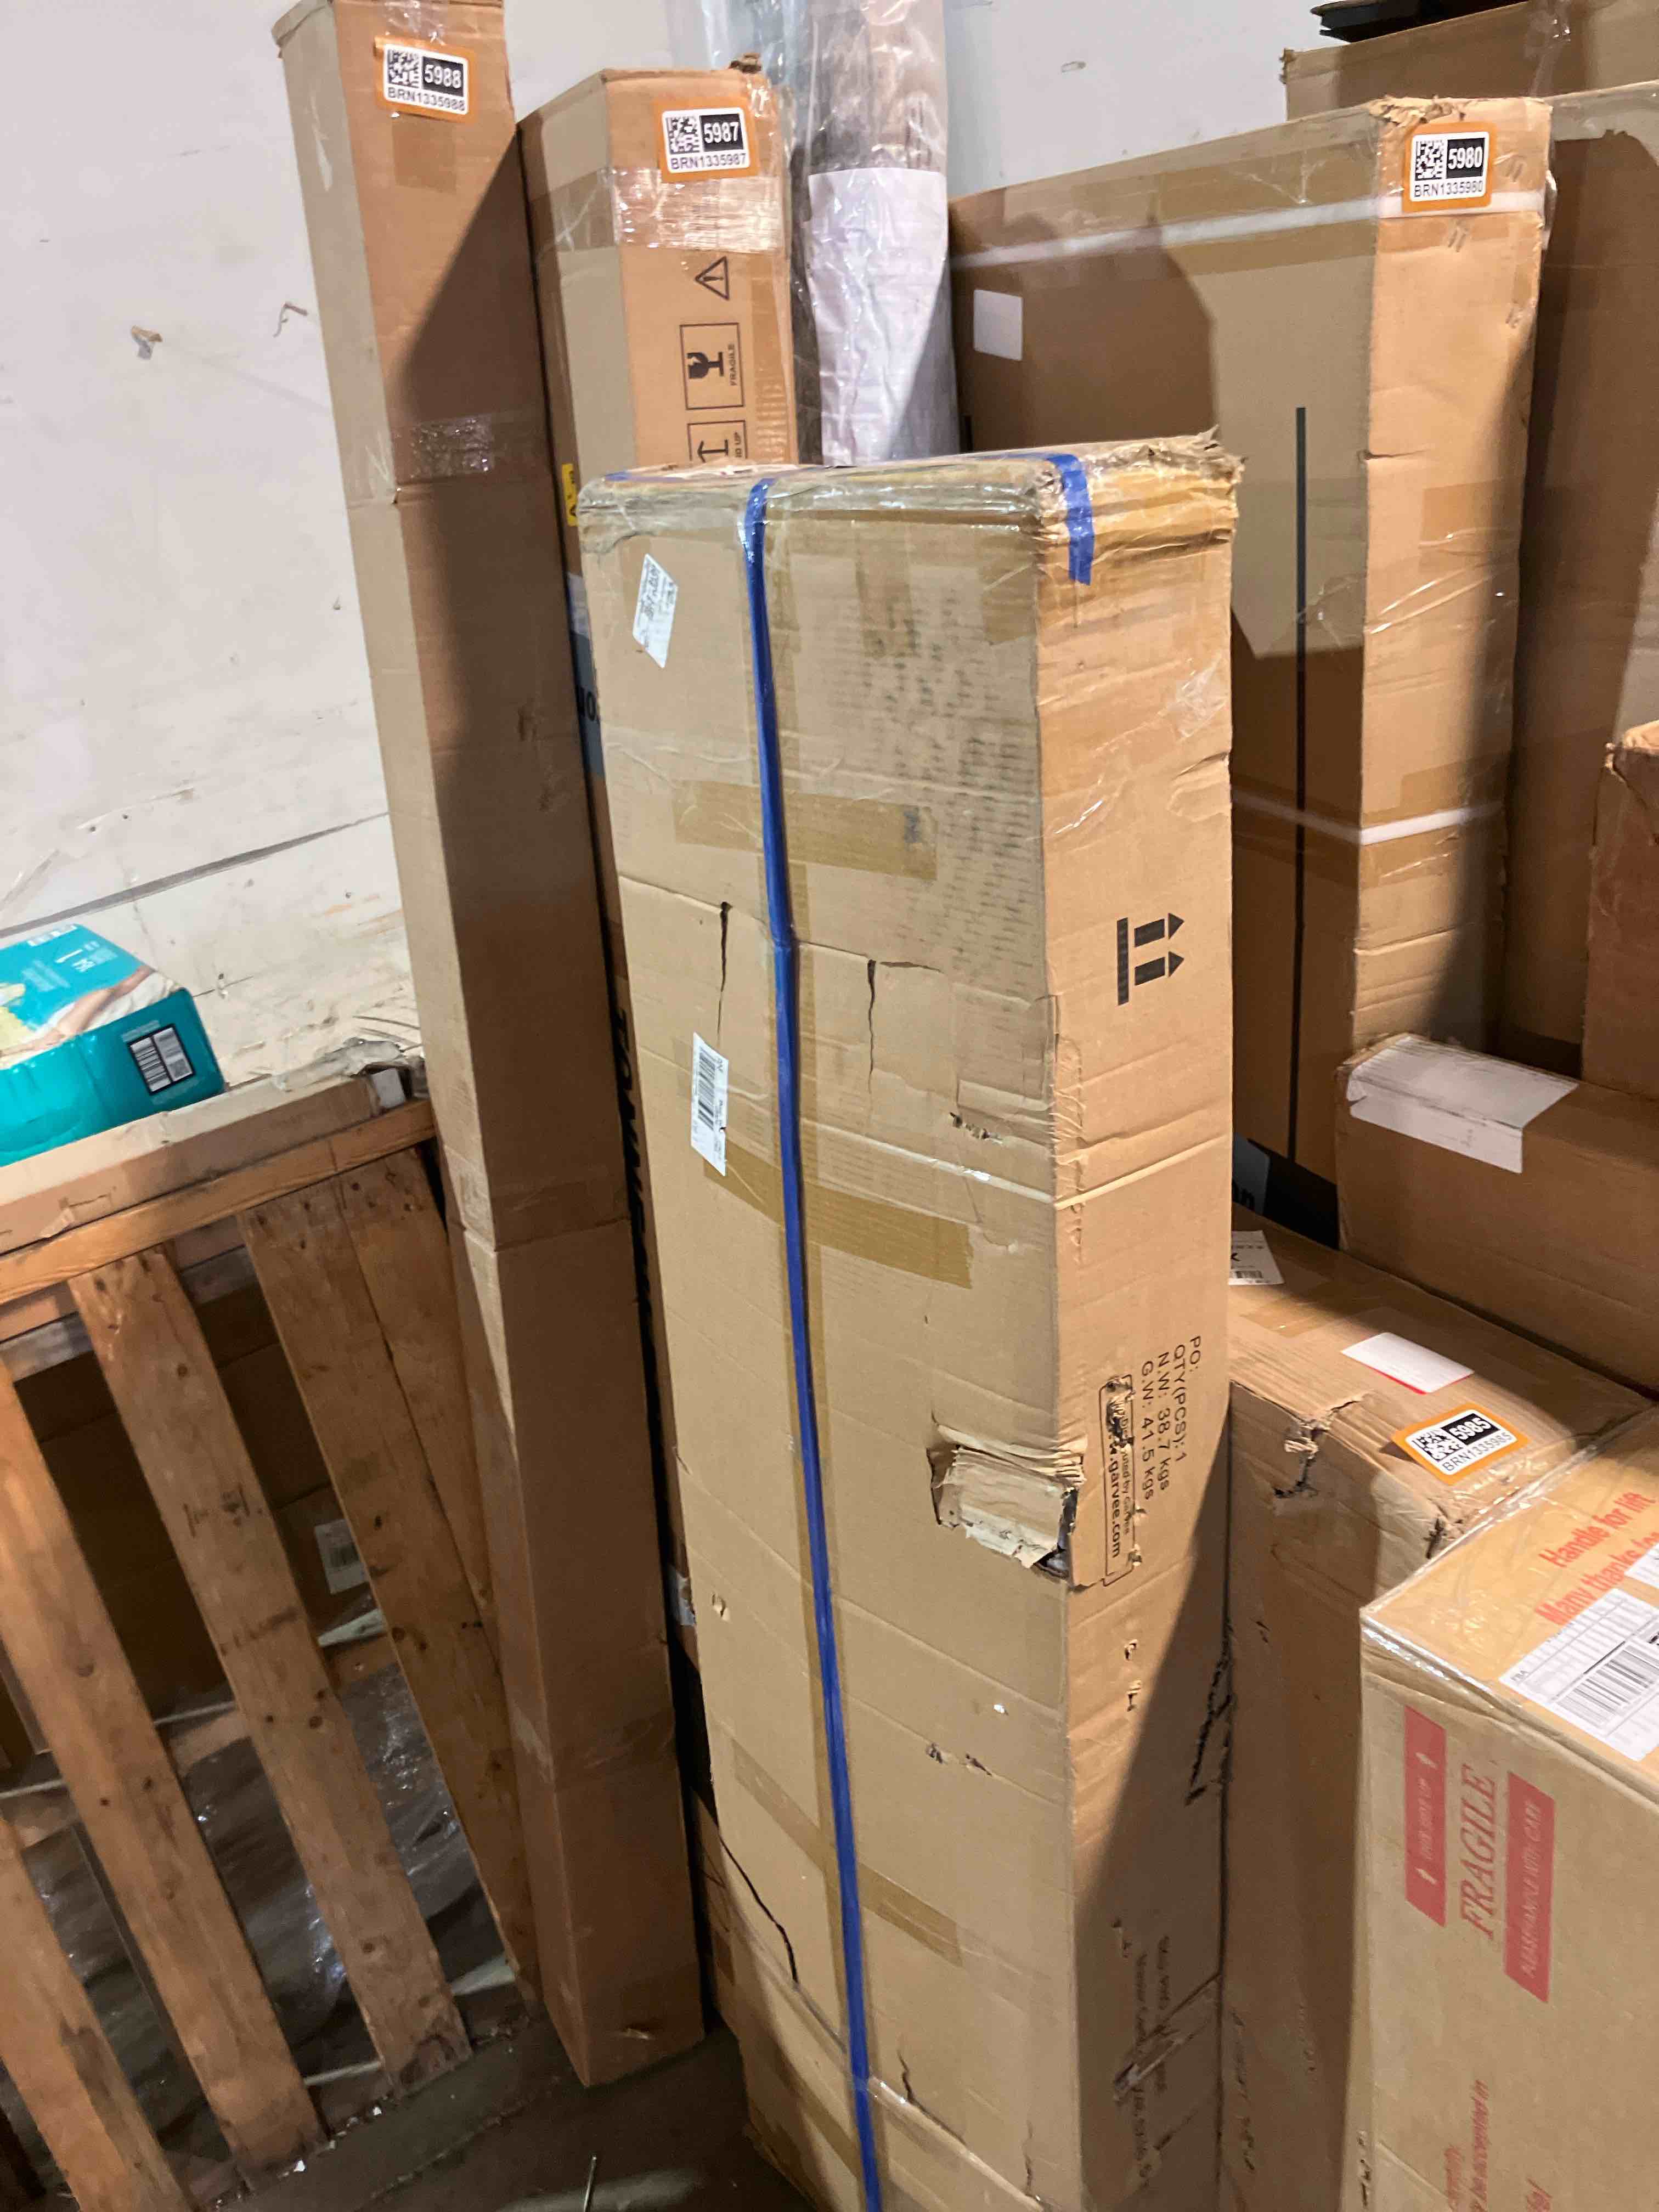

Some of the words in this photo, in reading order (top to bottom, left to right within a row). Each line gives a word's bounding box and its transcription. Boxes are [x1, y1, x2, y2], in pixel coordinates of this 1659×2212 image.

[424, 64, 461, 89] 5988
[387, 87, 465, 111] BRN1335988
[703, 121, 739, 144] 5987
[670, 153, 747, 170] BRN1335987
[1448, 146, 1483, 170] 5980
[727, 343, 738, 386] FRAGILE
[1142, 1417, 1154, 1462] 41.5
[1158, 1408, 1170, 1449] 38.7
[1449, 1417, 1491, 1440] 5985
[1142, 1466, 1155, 1500] kgs
[1158, 1457, 1171, 1490] kgs
[1538, 1526, 1610, 1568] Handle
[1460, 1763, 1496, 1941] FRAGILE
